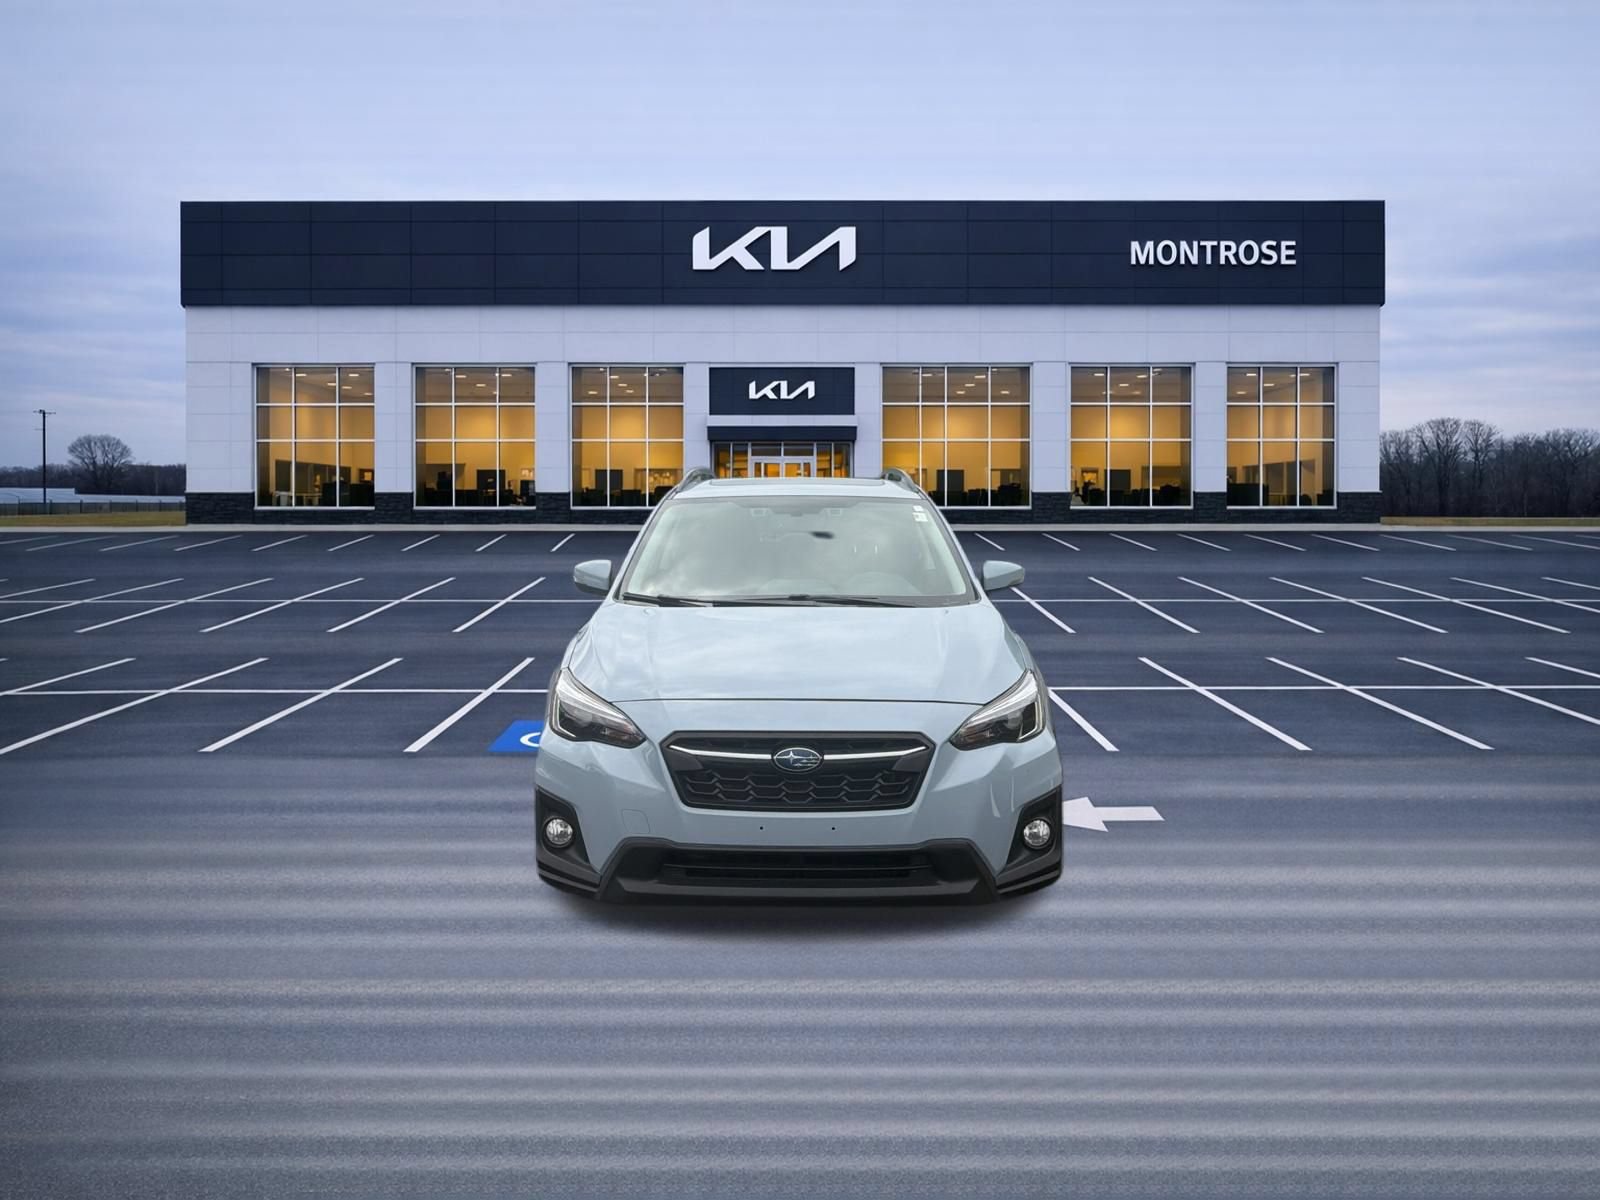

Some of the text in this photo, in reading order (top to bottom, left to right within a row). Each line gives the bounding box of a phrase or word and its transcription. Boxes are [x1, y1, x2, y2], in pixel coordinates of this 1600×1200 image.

[692, 226, 857, 271] KIA
[1130, 240, 1297, 266] MONTROSE
[748, 380, 816, 400] KIA
